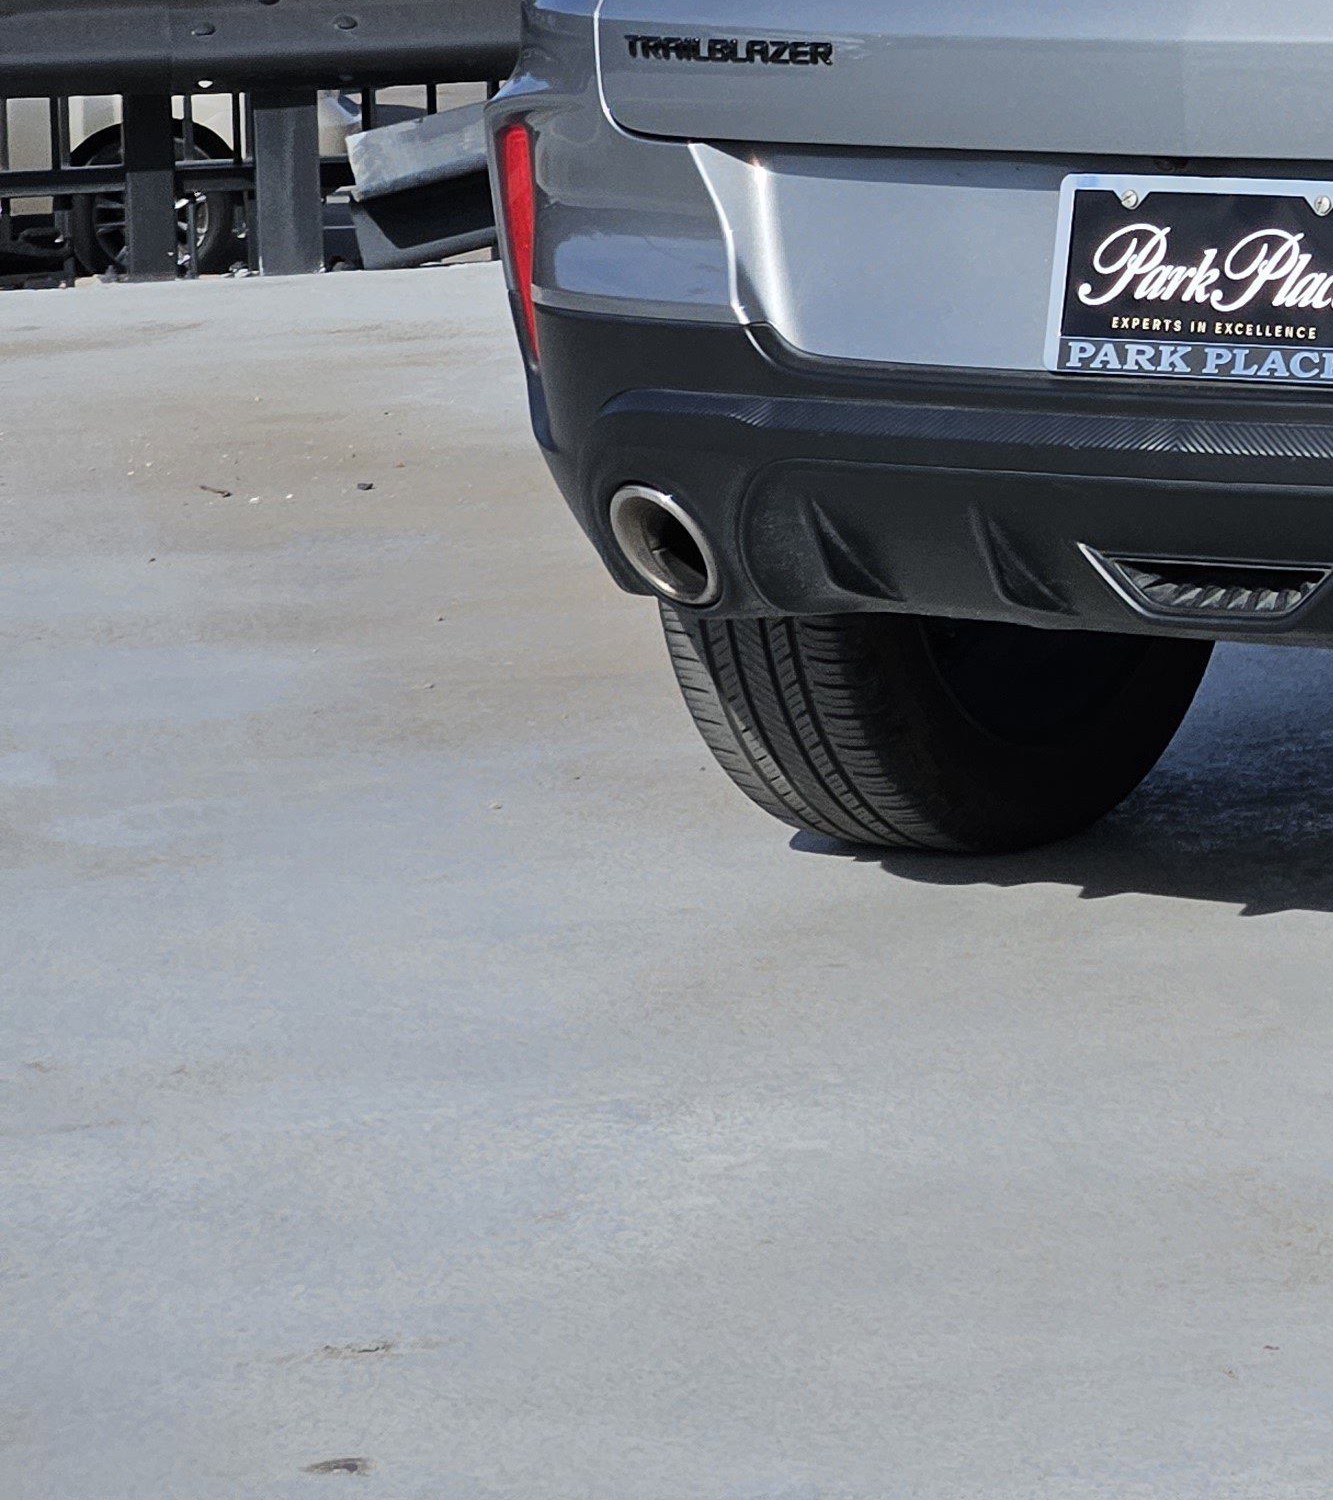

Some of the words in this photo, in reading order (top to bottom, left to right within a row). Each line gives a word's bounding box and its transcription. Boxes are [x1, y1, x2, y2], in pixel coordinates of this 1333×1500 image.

[624, 34, 833, 66] TRAILBLAZER
[1077, 222, 1221, 306] Park
[1111, 316, 1182, 332] EXPERTS
[1190, 320, 1206, 333] IN
[1214, 322, 1317, 340] EXCELLENCE
[1066, 341, 1192, 374] PARK
